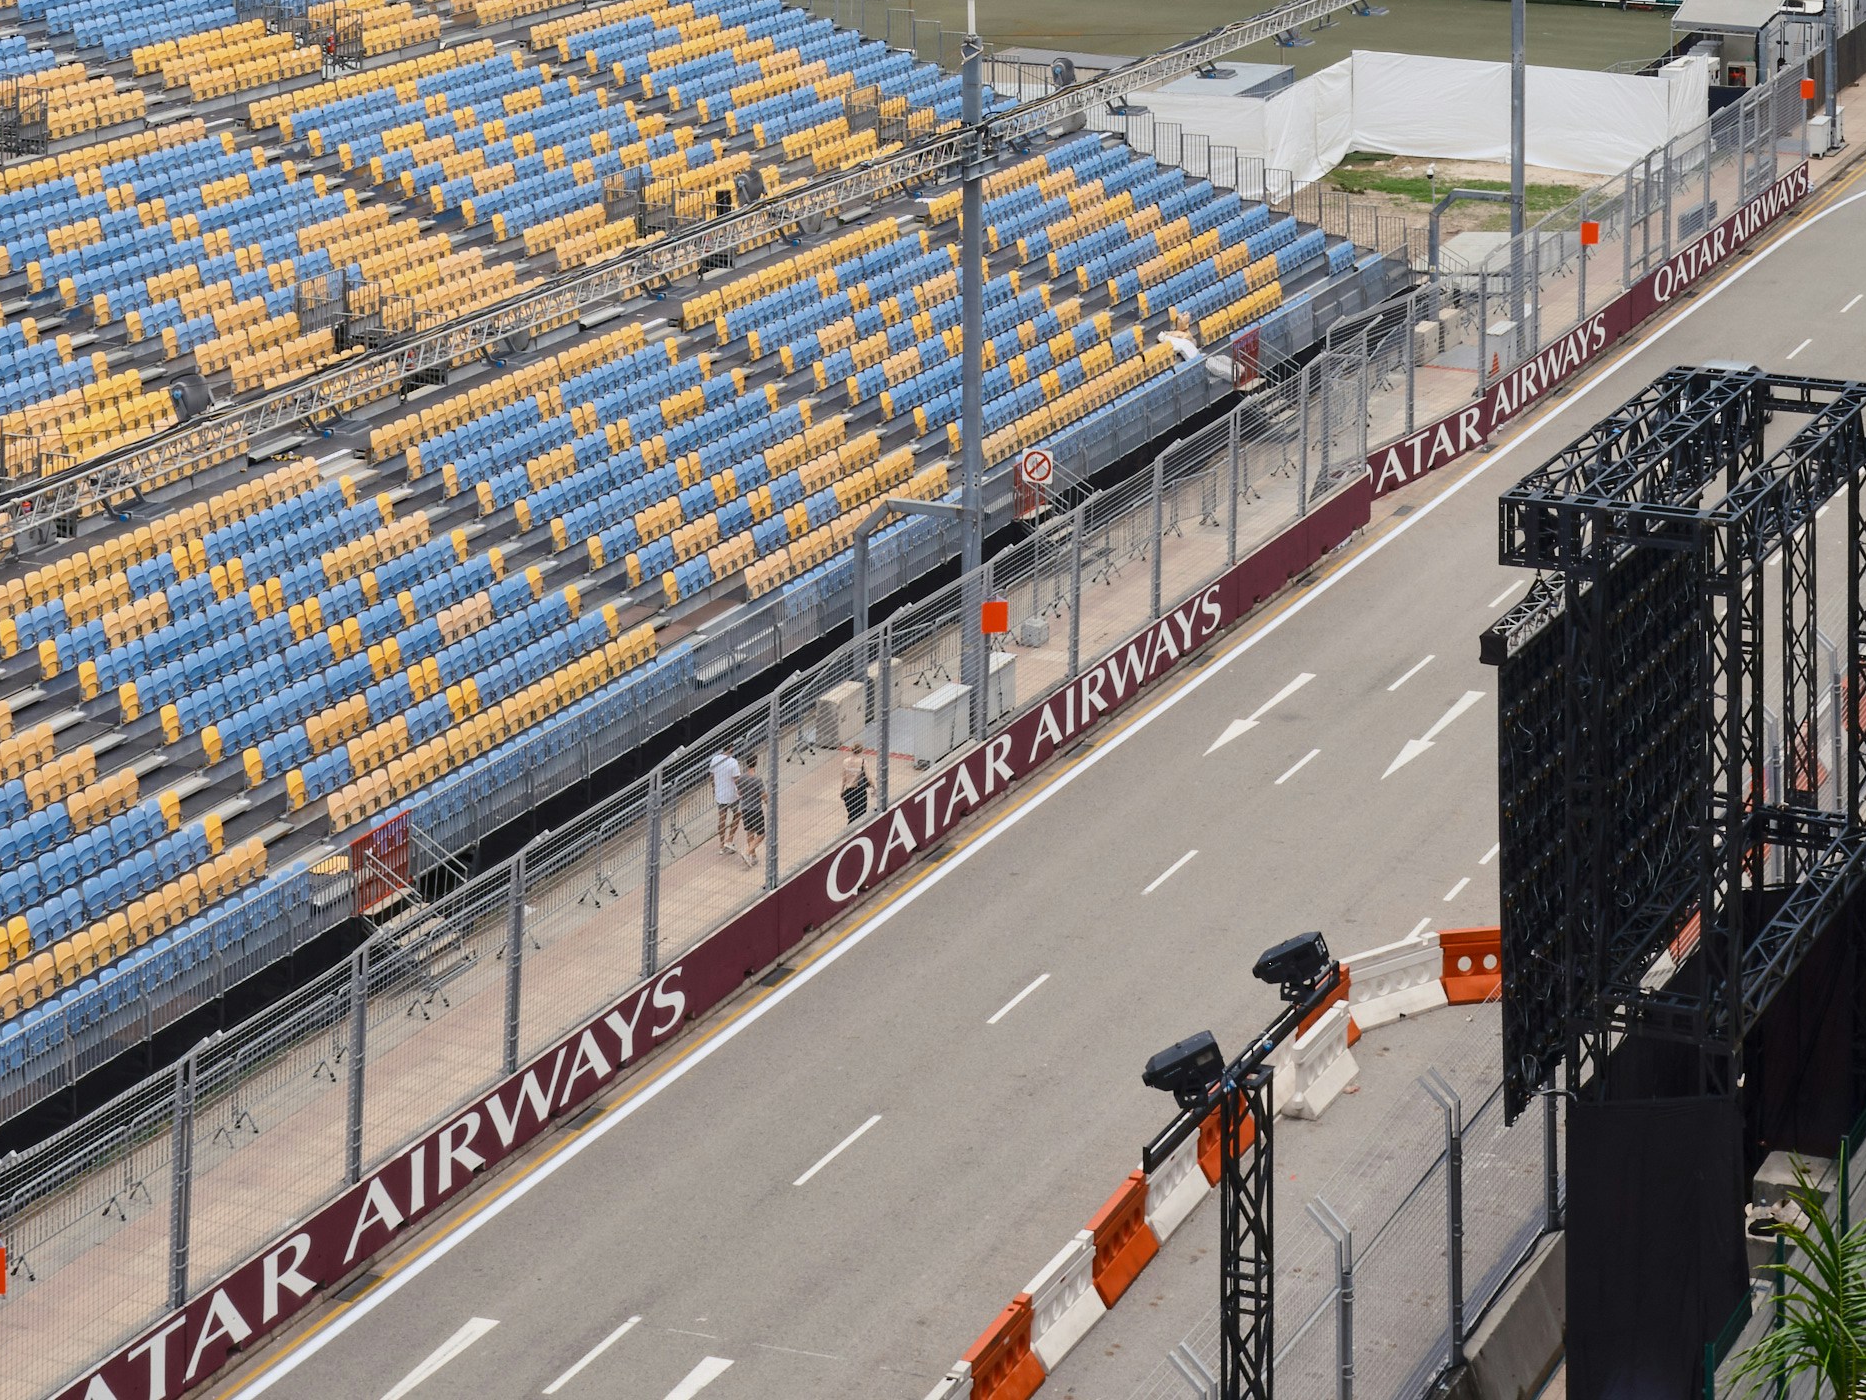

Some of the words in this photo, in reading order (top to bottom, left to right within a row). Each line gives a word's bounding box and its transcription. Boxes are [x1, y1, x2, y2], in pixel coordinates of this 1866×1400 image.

[1653, 226, 1727, 303] QATAR
[1730, 165, 1807, 249] AIRWAYS
[1366, 406, 1483, 493] ATAR
[1490, 312, 1607, 426] AIRWAYS
[826, 732, 1014, 903] QATAR
[1028, 584, 1224, 764] AIRWAYS
[342, 965, 686, 1265] AIRWAYS
